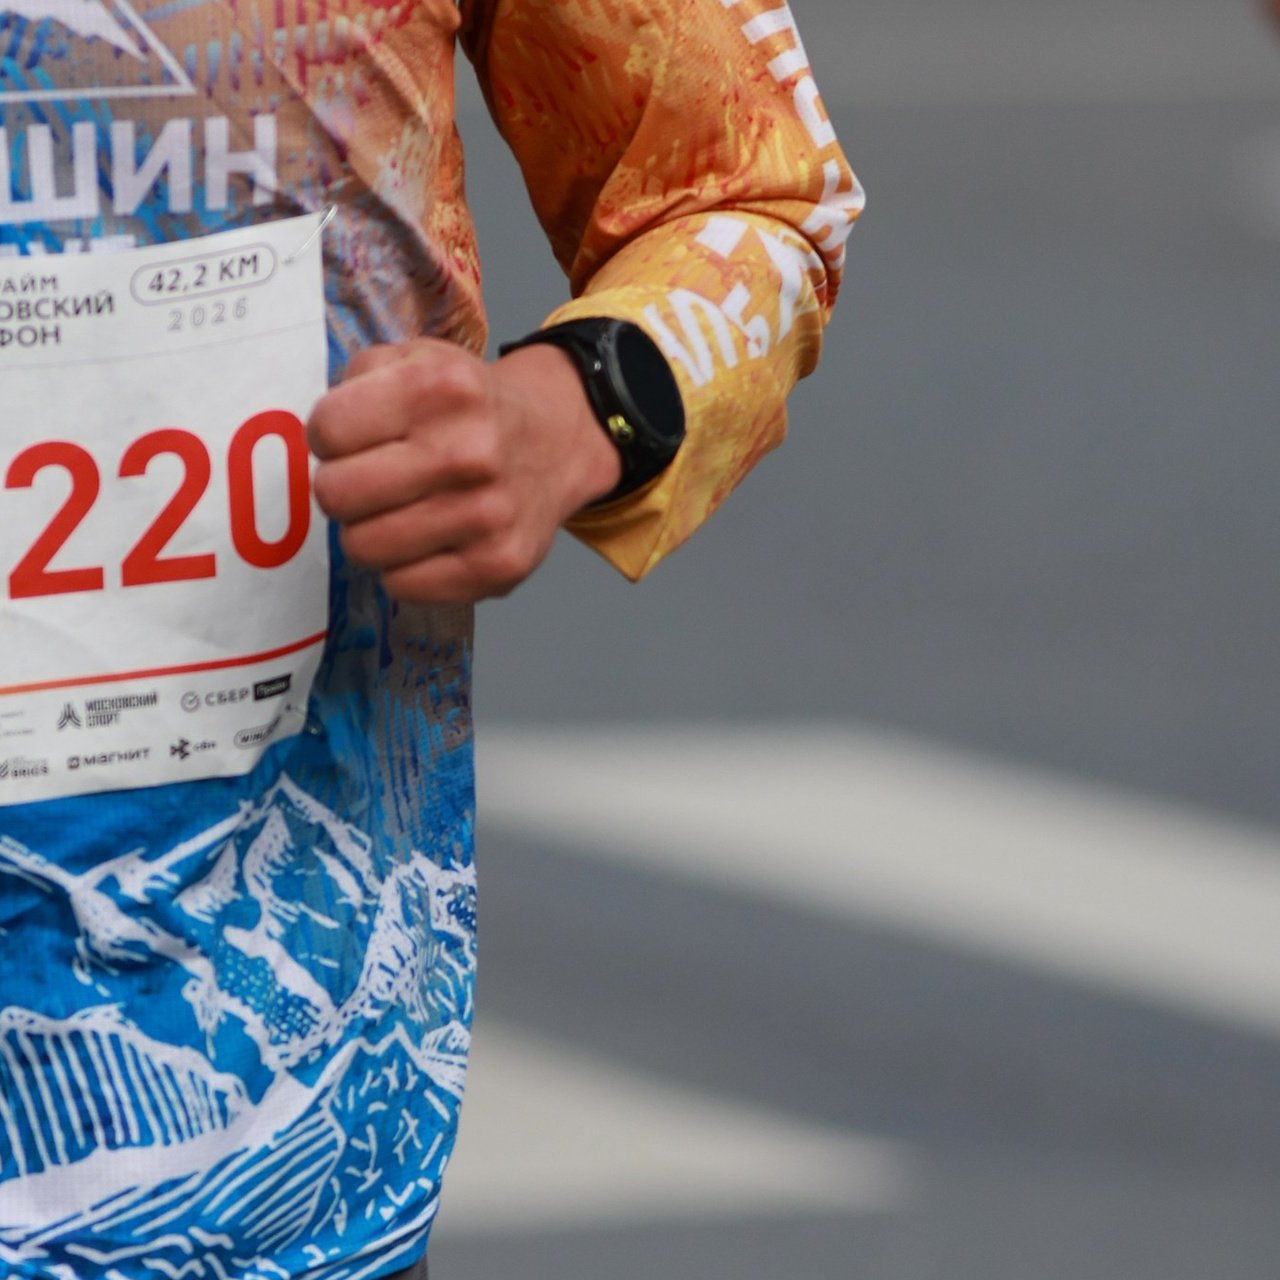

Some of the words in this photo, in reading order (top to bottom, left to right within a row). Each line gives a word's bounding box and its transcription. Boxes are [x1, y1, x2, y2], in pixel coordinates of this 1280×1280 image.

[149, 264, 207, 293] 42,2
[220, 253, 259, 282] КМ
[168, 297, 248, 332] 2026
[204, 688, 249, 707] СБЕР
